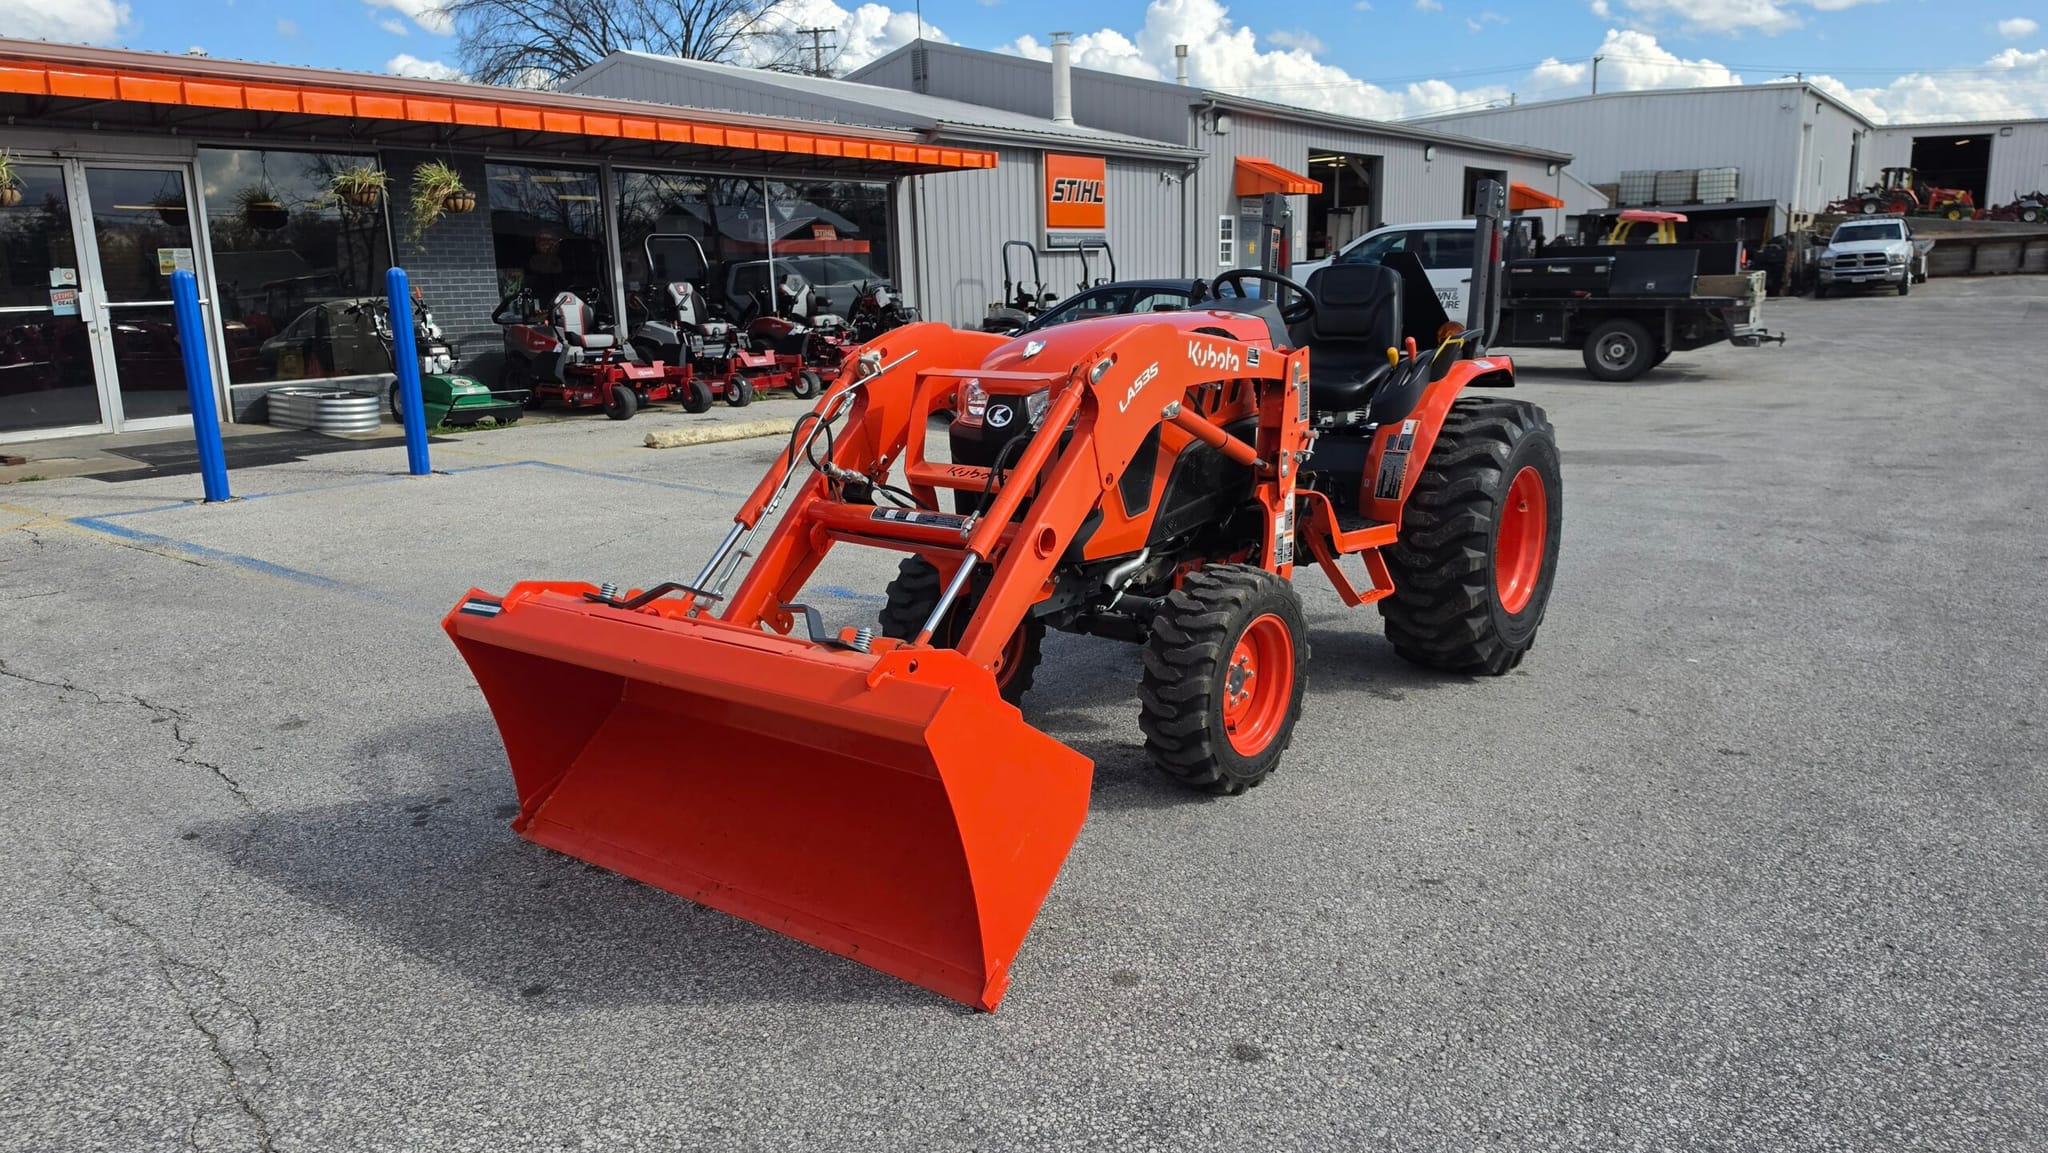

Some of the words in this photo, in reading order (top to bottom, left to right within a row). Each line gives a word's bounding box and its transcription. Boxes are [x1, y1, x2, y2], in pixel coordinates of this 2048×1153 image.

[1051, 178, 1105, 204] STIHL
[1188, 340, 1240, 372] Kubota
[1118, 362, 1159, 413] LA535
